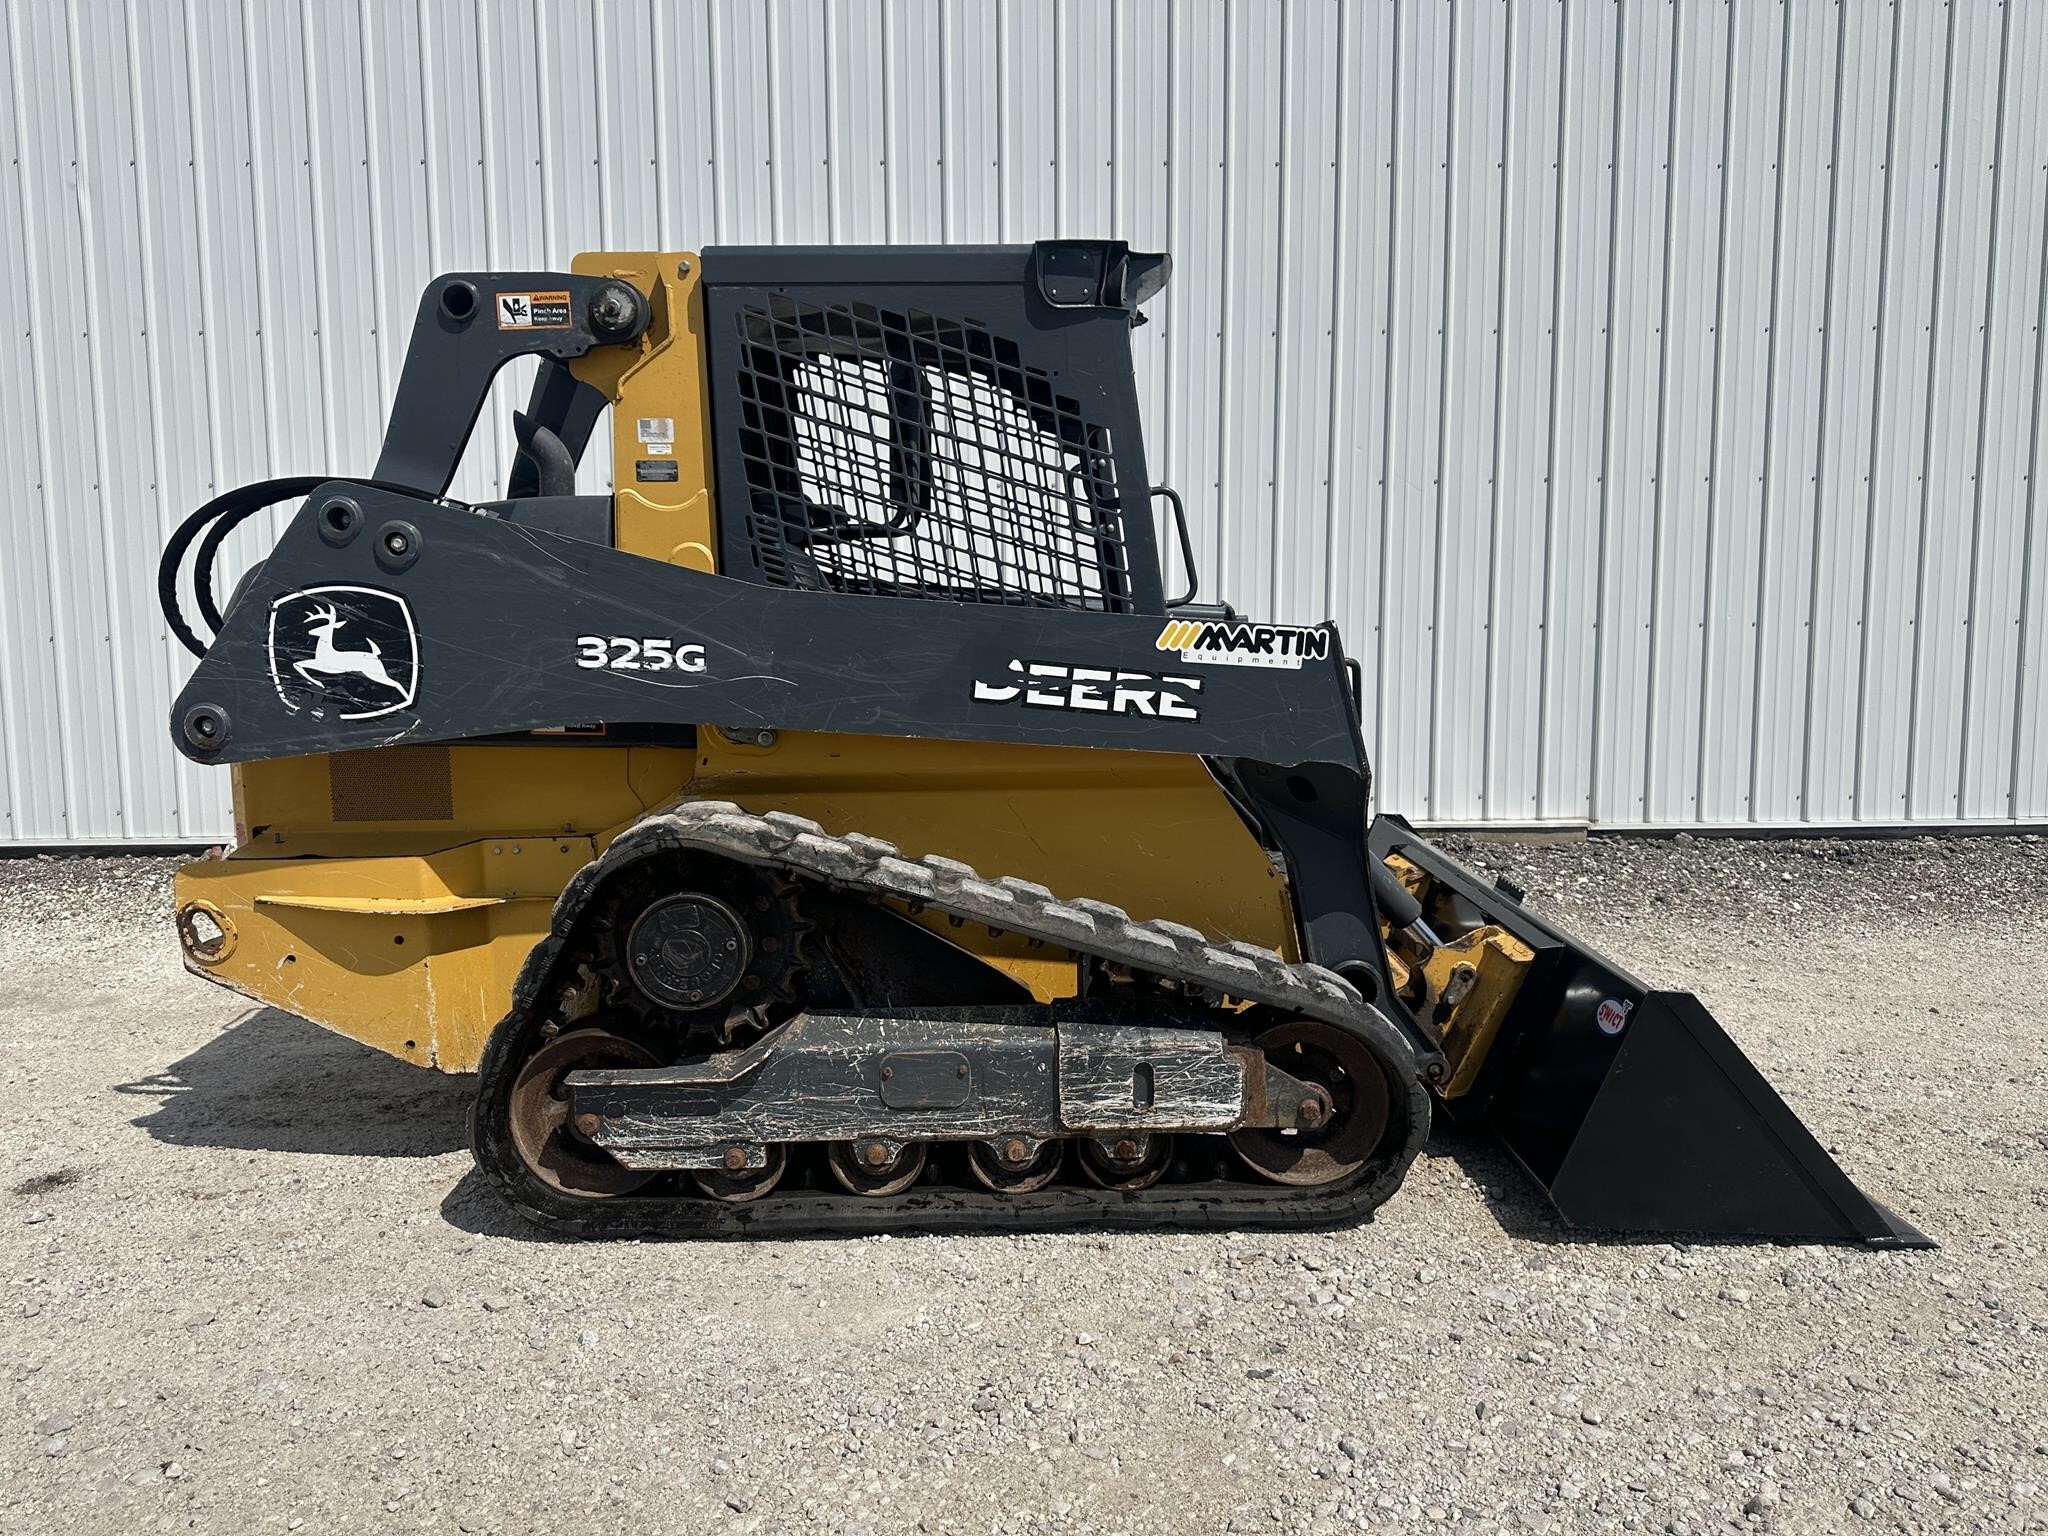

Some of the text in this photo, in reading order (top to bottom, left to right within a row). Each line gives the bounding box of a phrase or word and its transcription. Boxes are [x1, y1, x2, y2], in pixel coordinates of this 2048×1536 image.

[577, 636, 706, 672] 325G
[1194, 626, 1327, 658] MARTIN
[1182, 652, 1301, 666] Equipment
